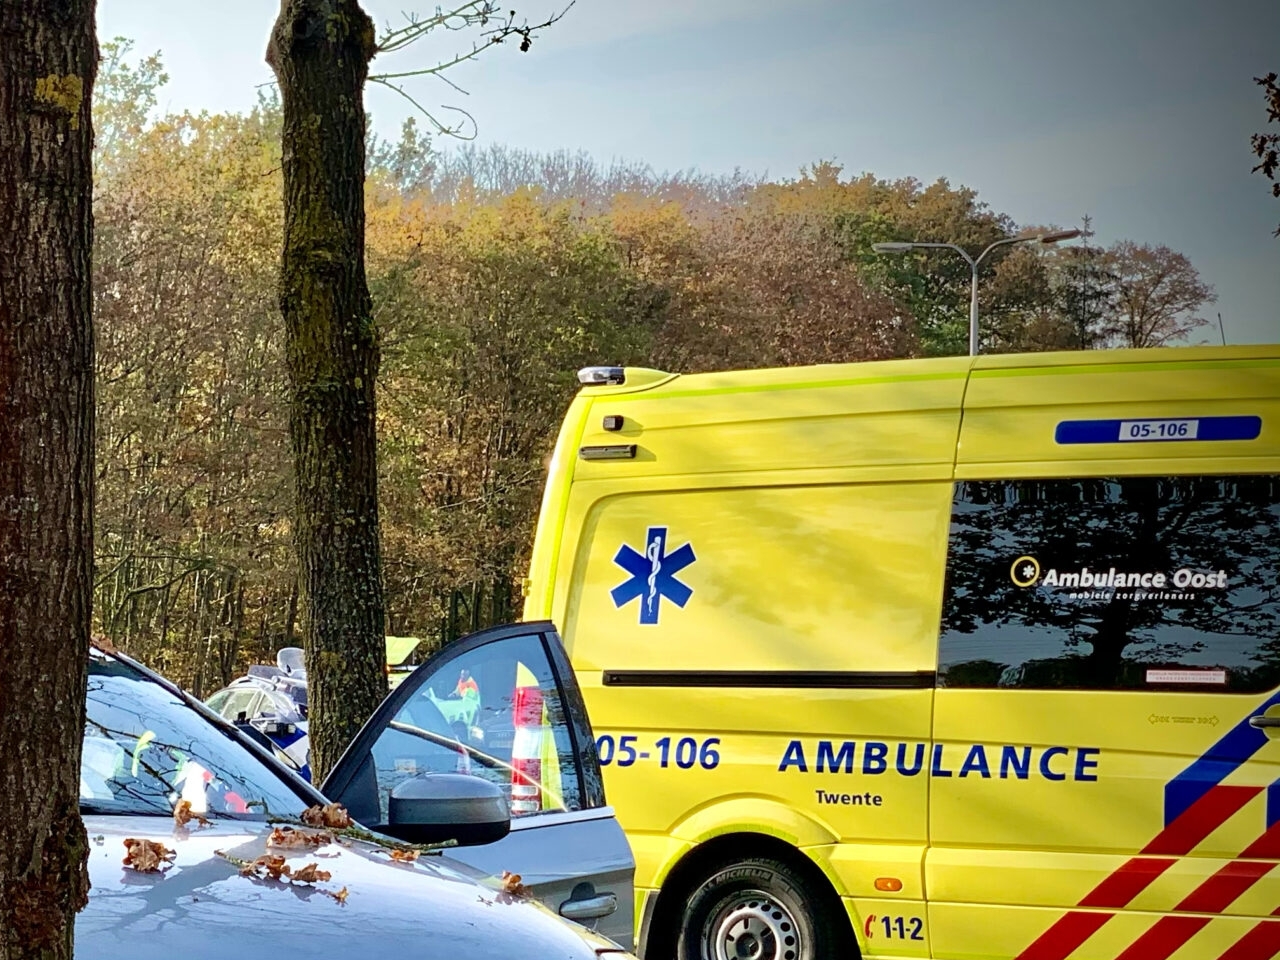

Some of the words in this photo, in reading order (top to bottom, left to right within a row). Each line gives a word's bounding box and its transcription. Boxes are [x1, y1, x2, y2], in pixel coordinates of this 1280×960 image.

[1129, 421, 1188, 438] 05-106
[1042, 567, 1166, 588] Ambulance
[1172, 568, 1228, 588] Oost
[1069, 591, 1111, 600] mobiele
[1115, 591, 1195, 602] zorgverleners
[594, 734, 721, 769] 05-106
[778, 739, 1101, 782] AMBULANCE
[815, 790, 883, 807] Twente
[716, 868, 772, 884] MICHELIN
[881, 916, 924, 941] 1-1-2
